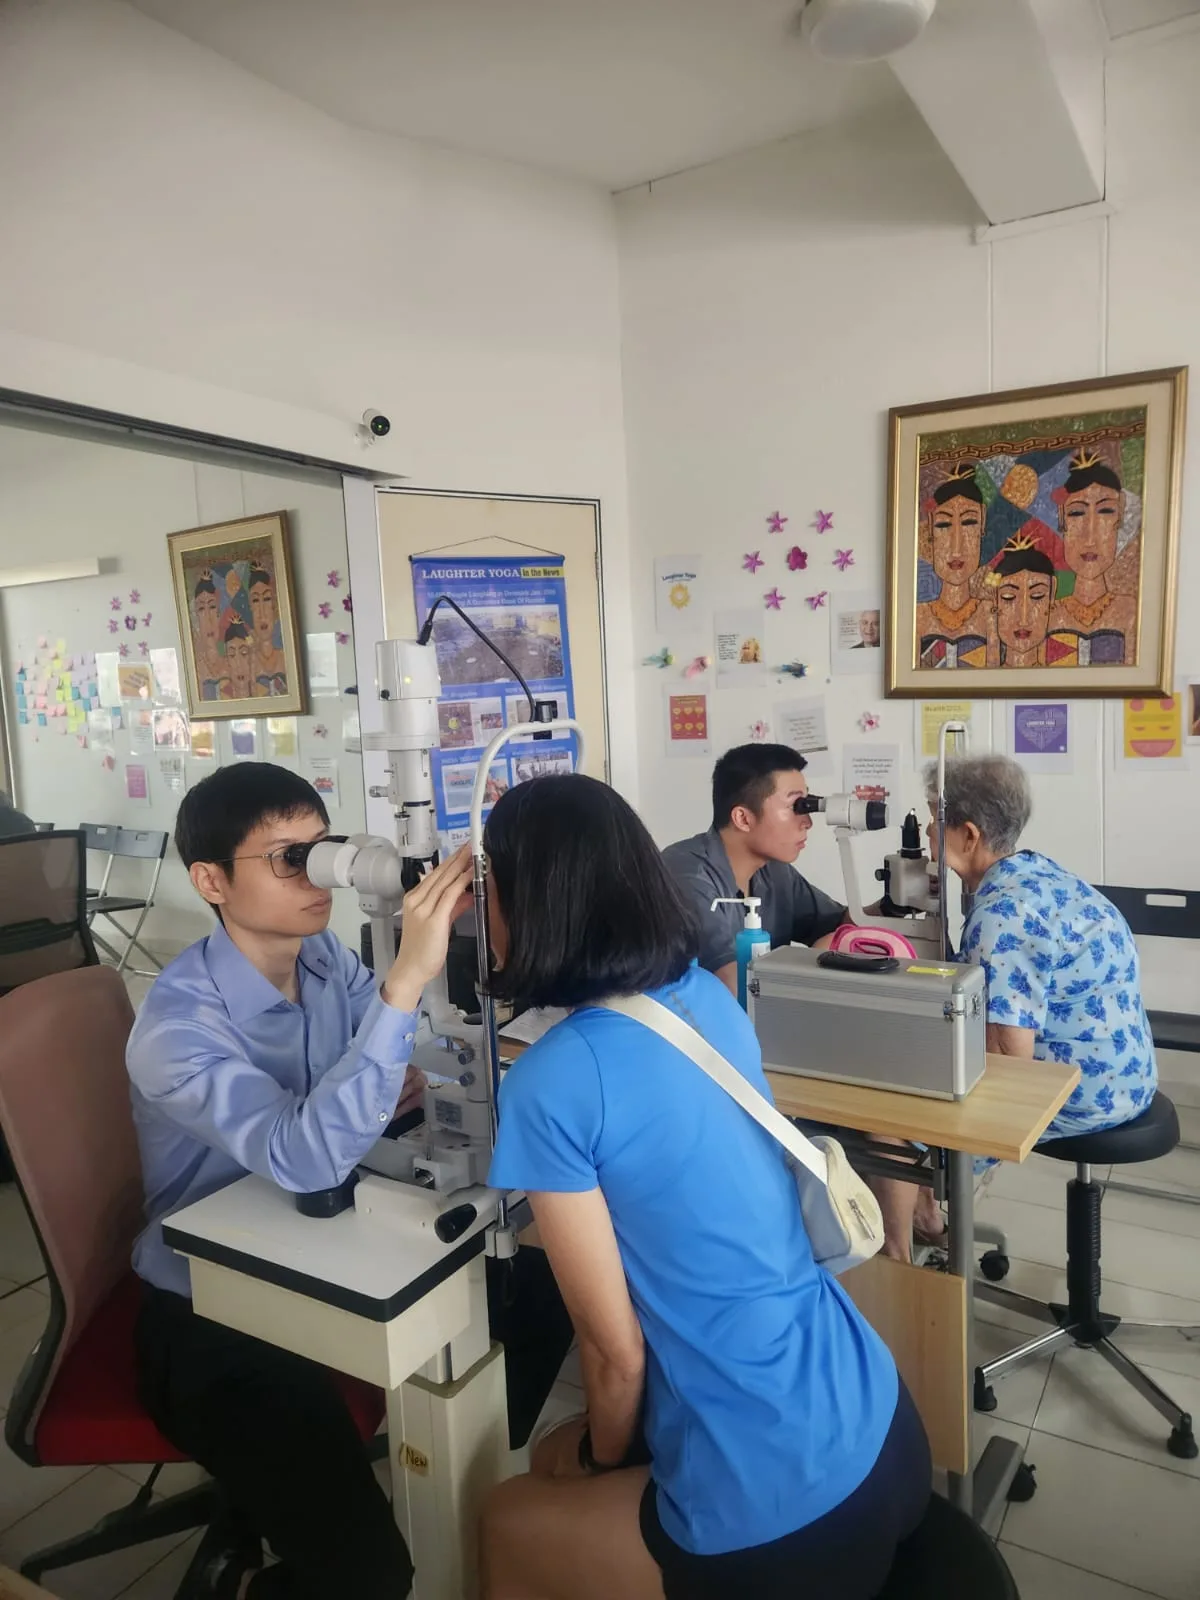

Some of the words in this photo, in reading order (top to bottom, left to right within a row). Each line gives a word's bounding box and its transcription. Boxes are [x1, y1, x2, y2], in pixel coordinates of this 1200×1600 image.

[422, 569, 486, 579] LAUGHTER
[488, 568, 520, 578] YOGA
[530, 568, 541, 577] the
[543, 568, 560, 577] News
[406, 1445, 428, 1467] New
